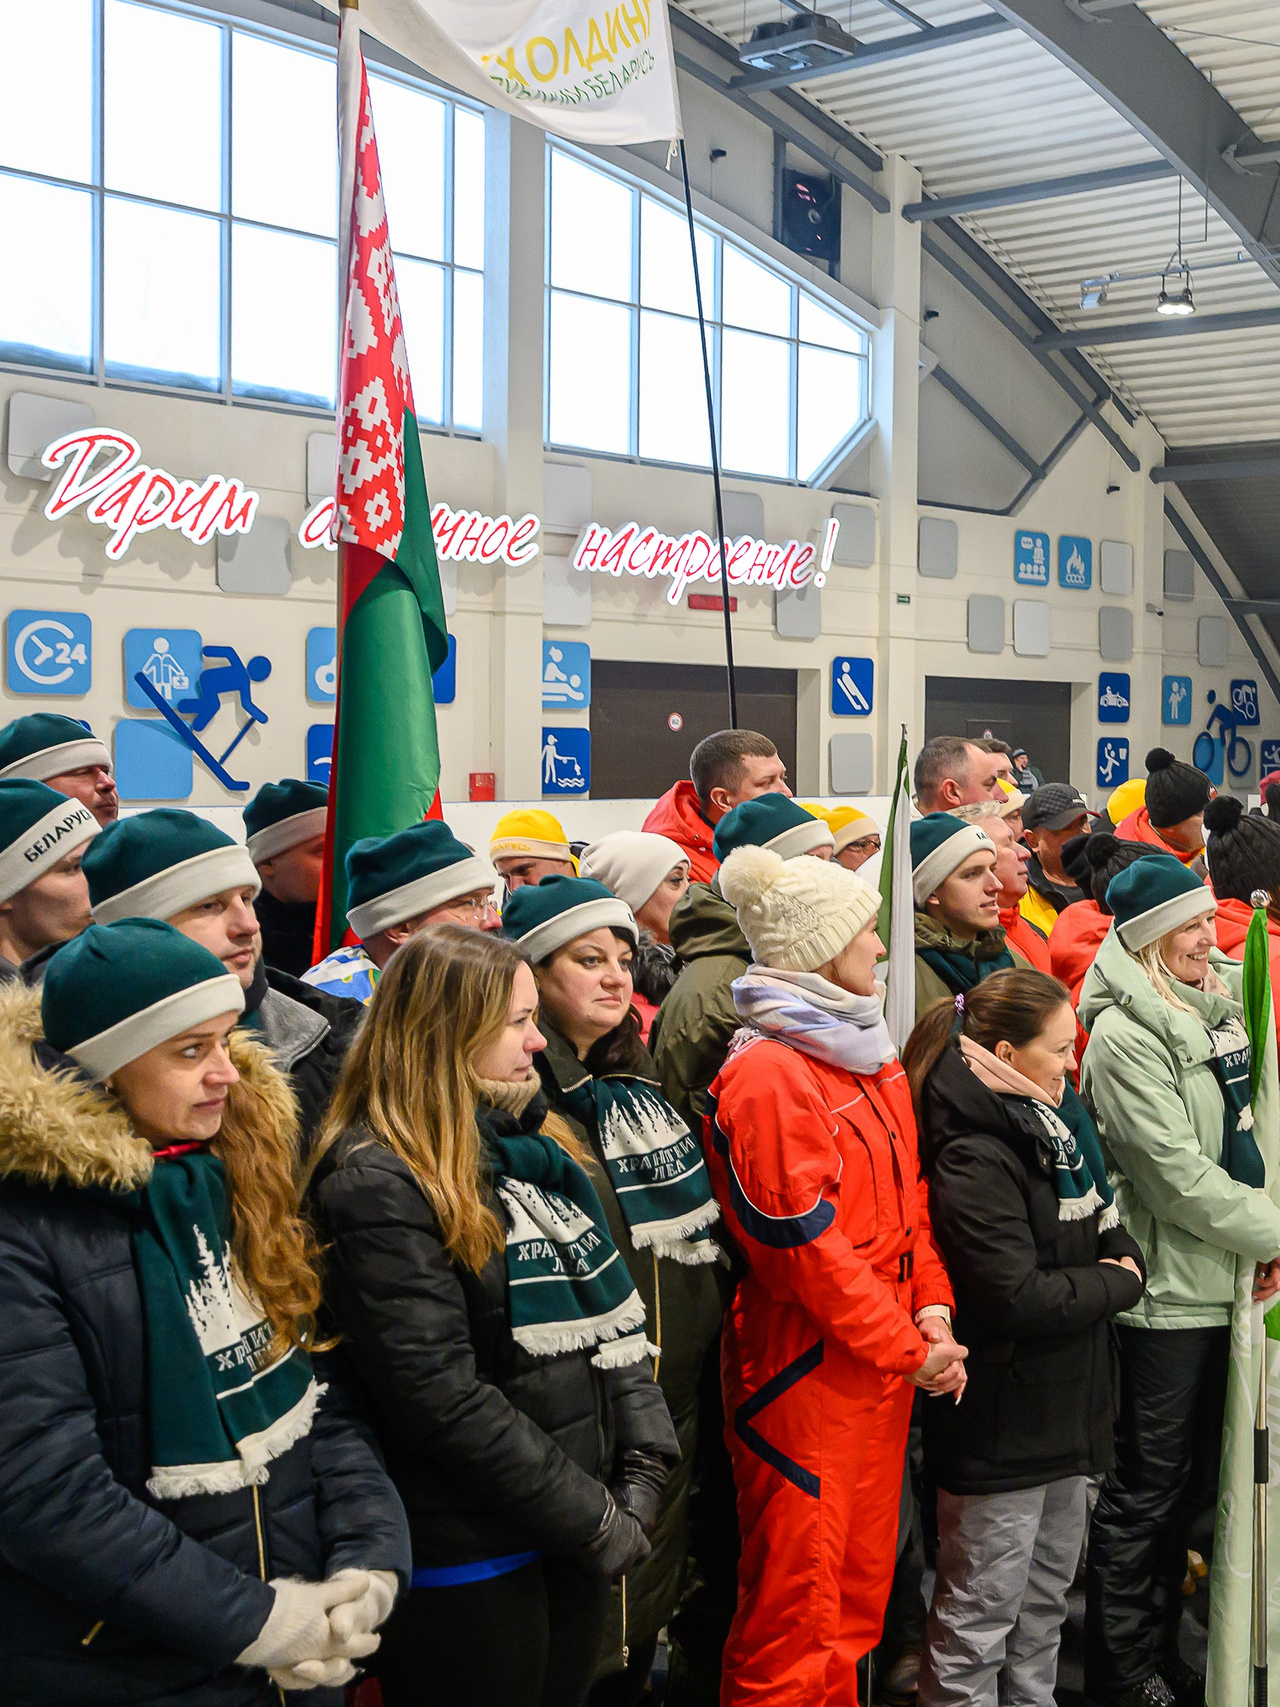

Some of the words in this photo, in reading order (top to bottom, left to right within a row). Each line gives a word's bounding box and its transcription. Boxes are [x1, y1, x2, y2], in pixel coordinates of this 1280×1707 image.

[481, 0, 651, 87] ХОЛДИН
[43, 429, 257, 558] Дарим
[299, 498, 540, 566] очное
[55, 642, 87, 665] 24
